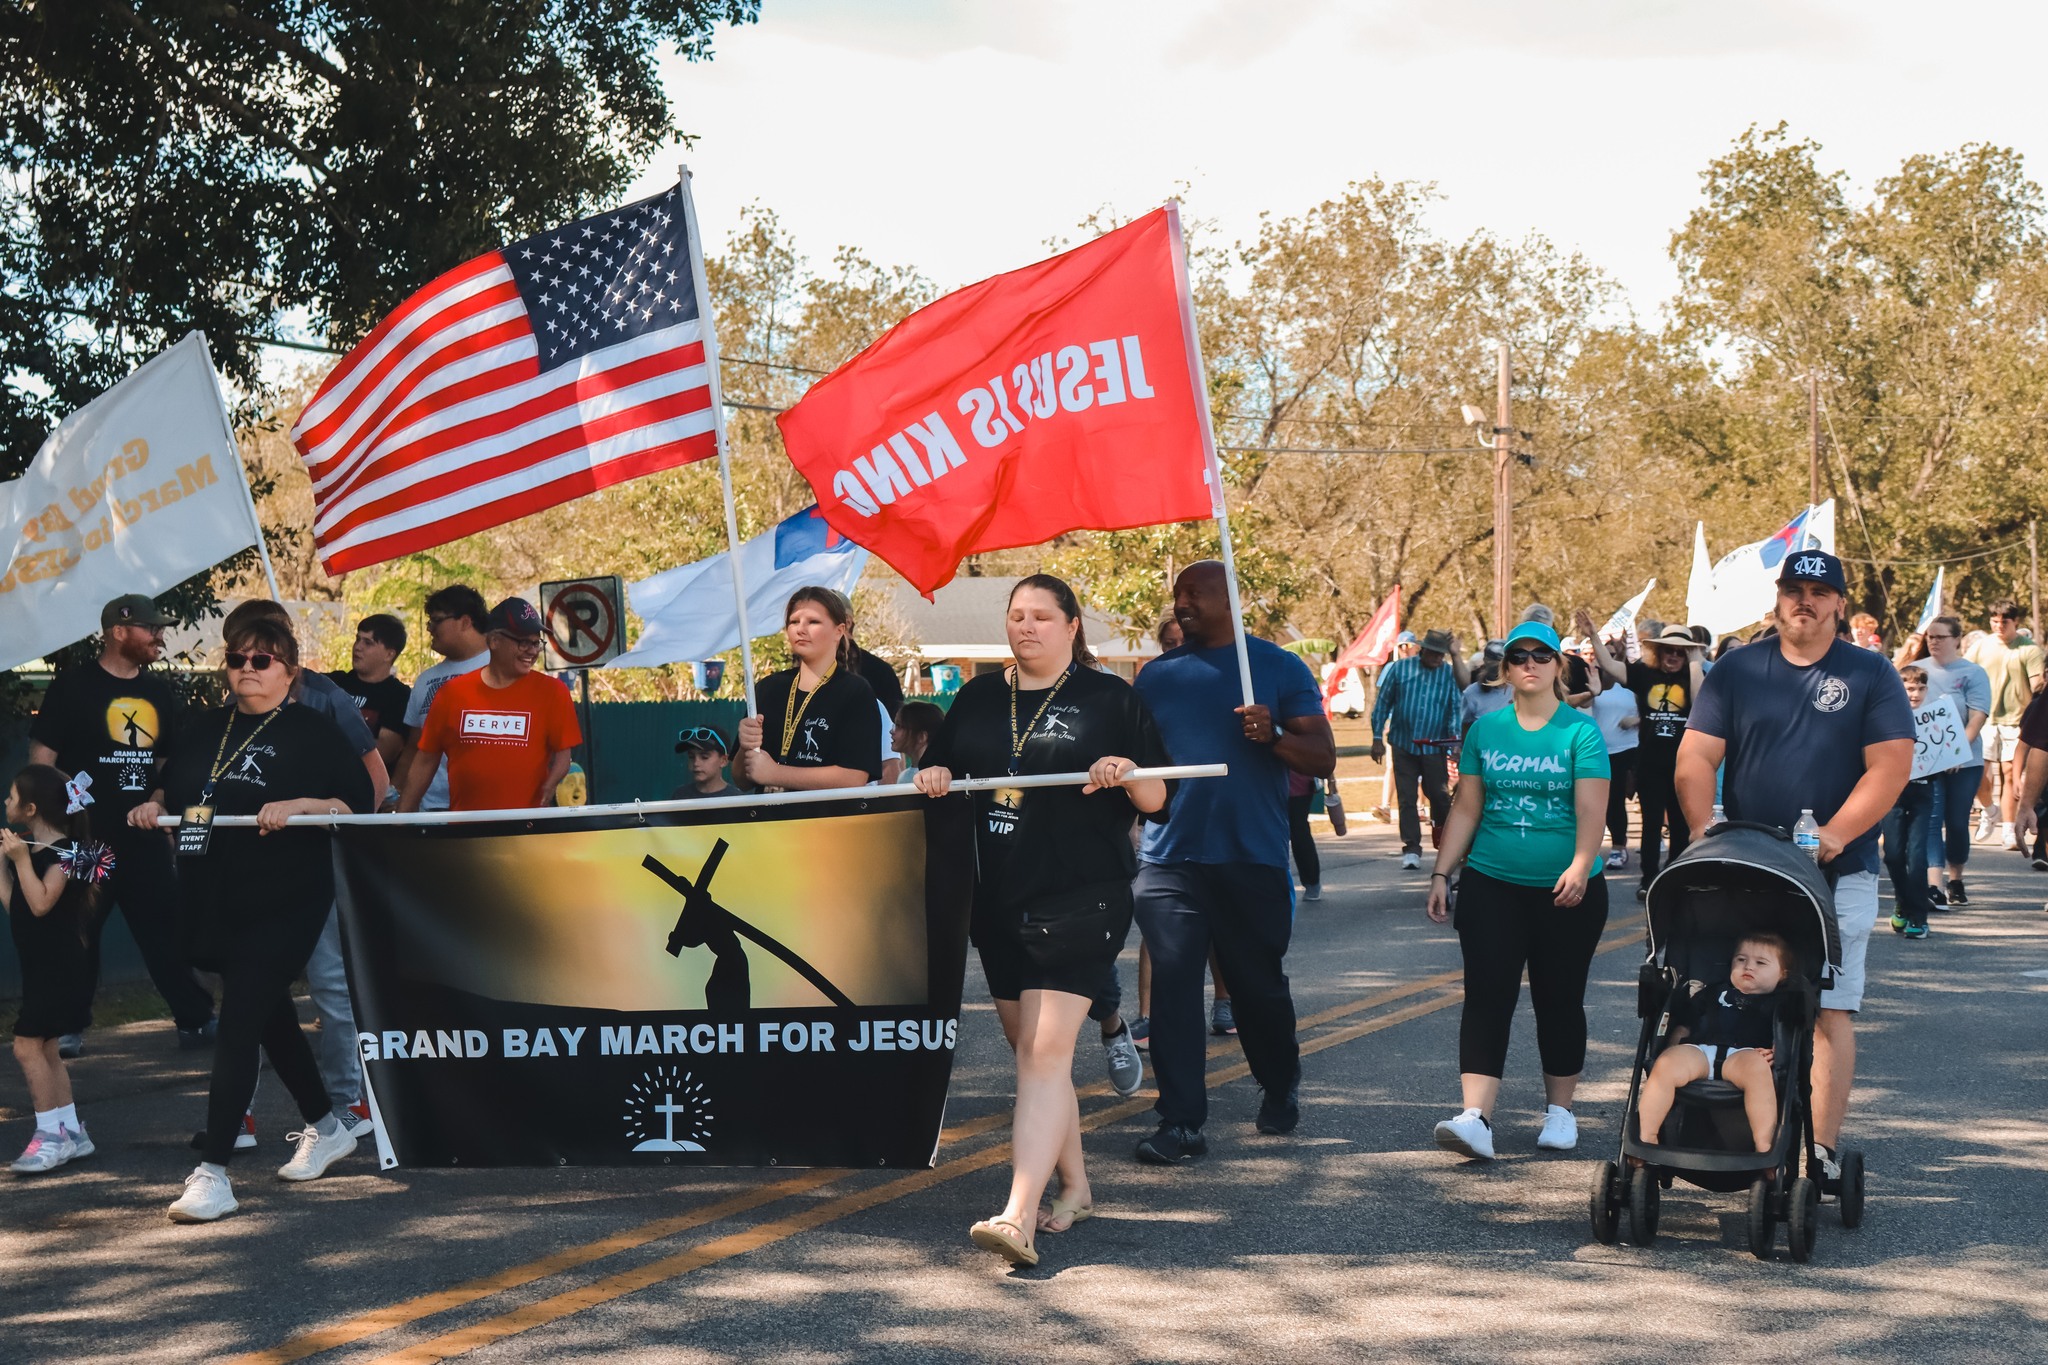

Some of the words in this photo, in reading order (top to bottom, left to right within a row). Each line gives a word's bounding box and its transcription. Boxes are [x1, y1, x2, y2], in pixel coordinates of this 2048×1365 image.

[467, 719, 522, 730] SERVE
[1914, 725, 1956, 755] SUS
[1496, 780, 1541, 790] COMING
[1548, 781, 1572, 791] BAC
[989, 820, 1014, 834] VIP
[358, 1030, 489, 1061] GRAND
[503, 1027, 587, 1058] BAY
[600, 1023, 744, 1055] MARCH
[759, 1022, 836, 1053] FOR
[848, 1018, 958, 1051] JESUS
